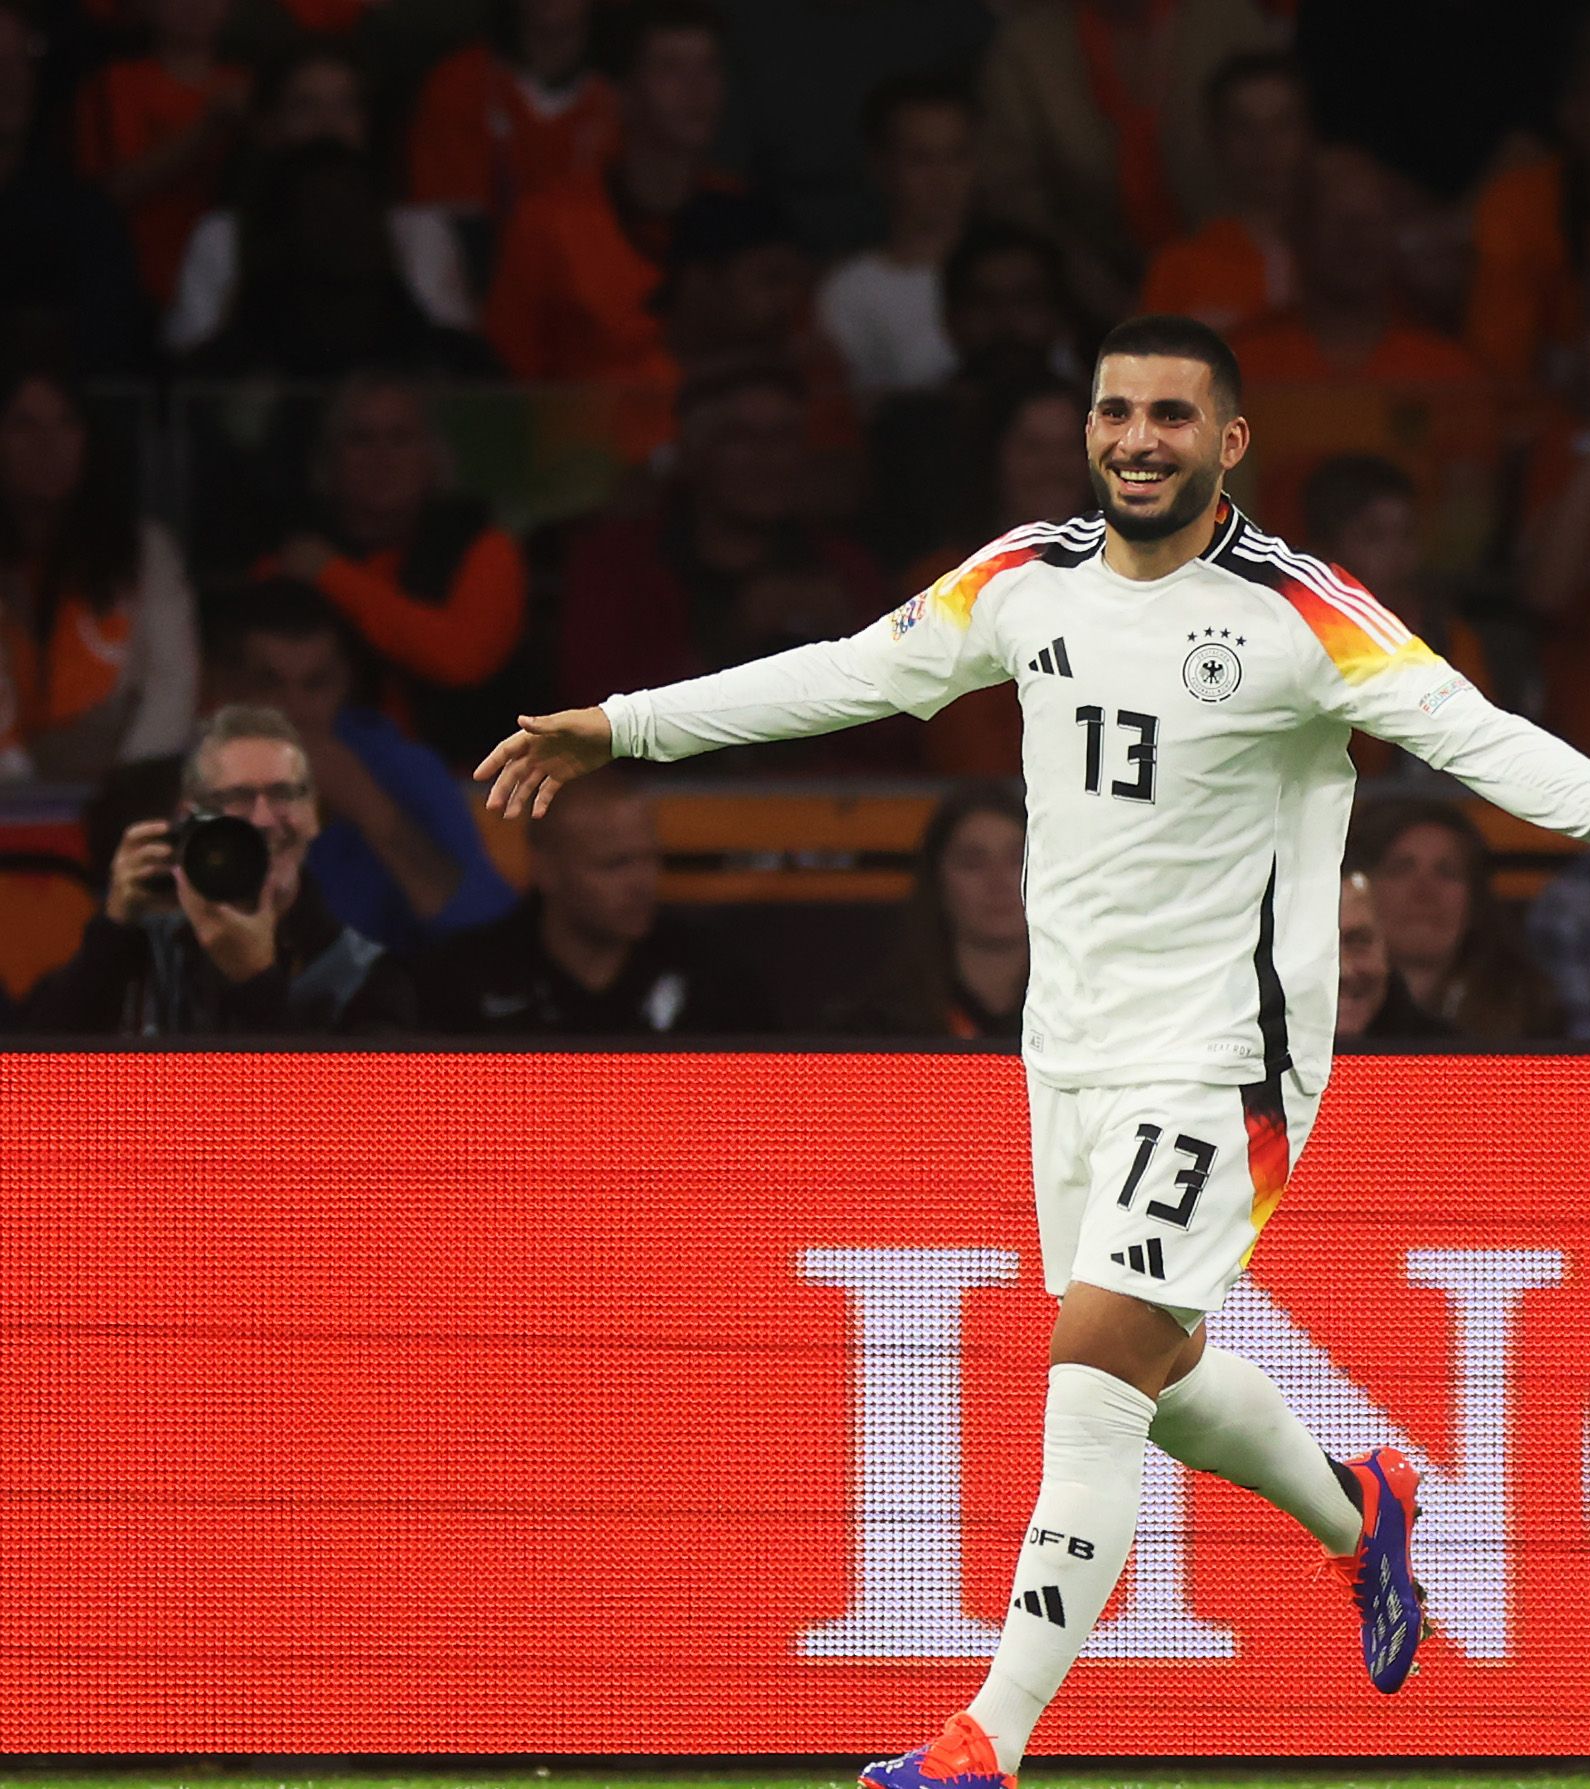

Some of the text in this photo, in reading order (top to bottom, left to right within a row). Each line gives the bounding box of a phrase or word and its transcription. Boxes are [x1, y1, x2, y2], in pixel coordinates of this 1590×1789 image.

[1075, 705, 1161, 805] 13
[1116, 1123, 1219, 1231] 13
[1029, 1527, 1096, 1561] DFB
